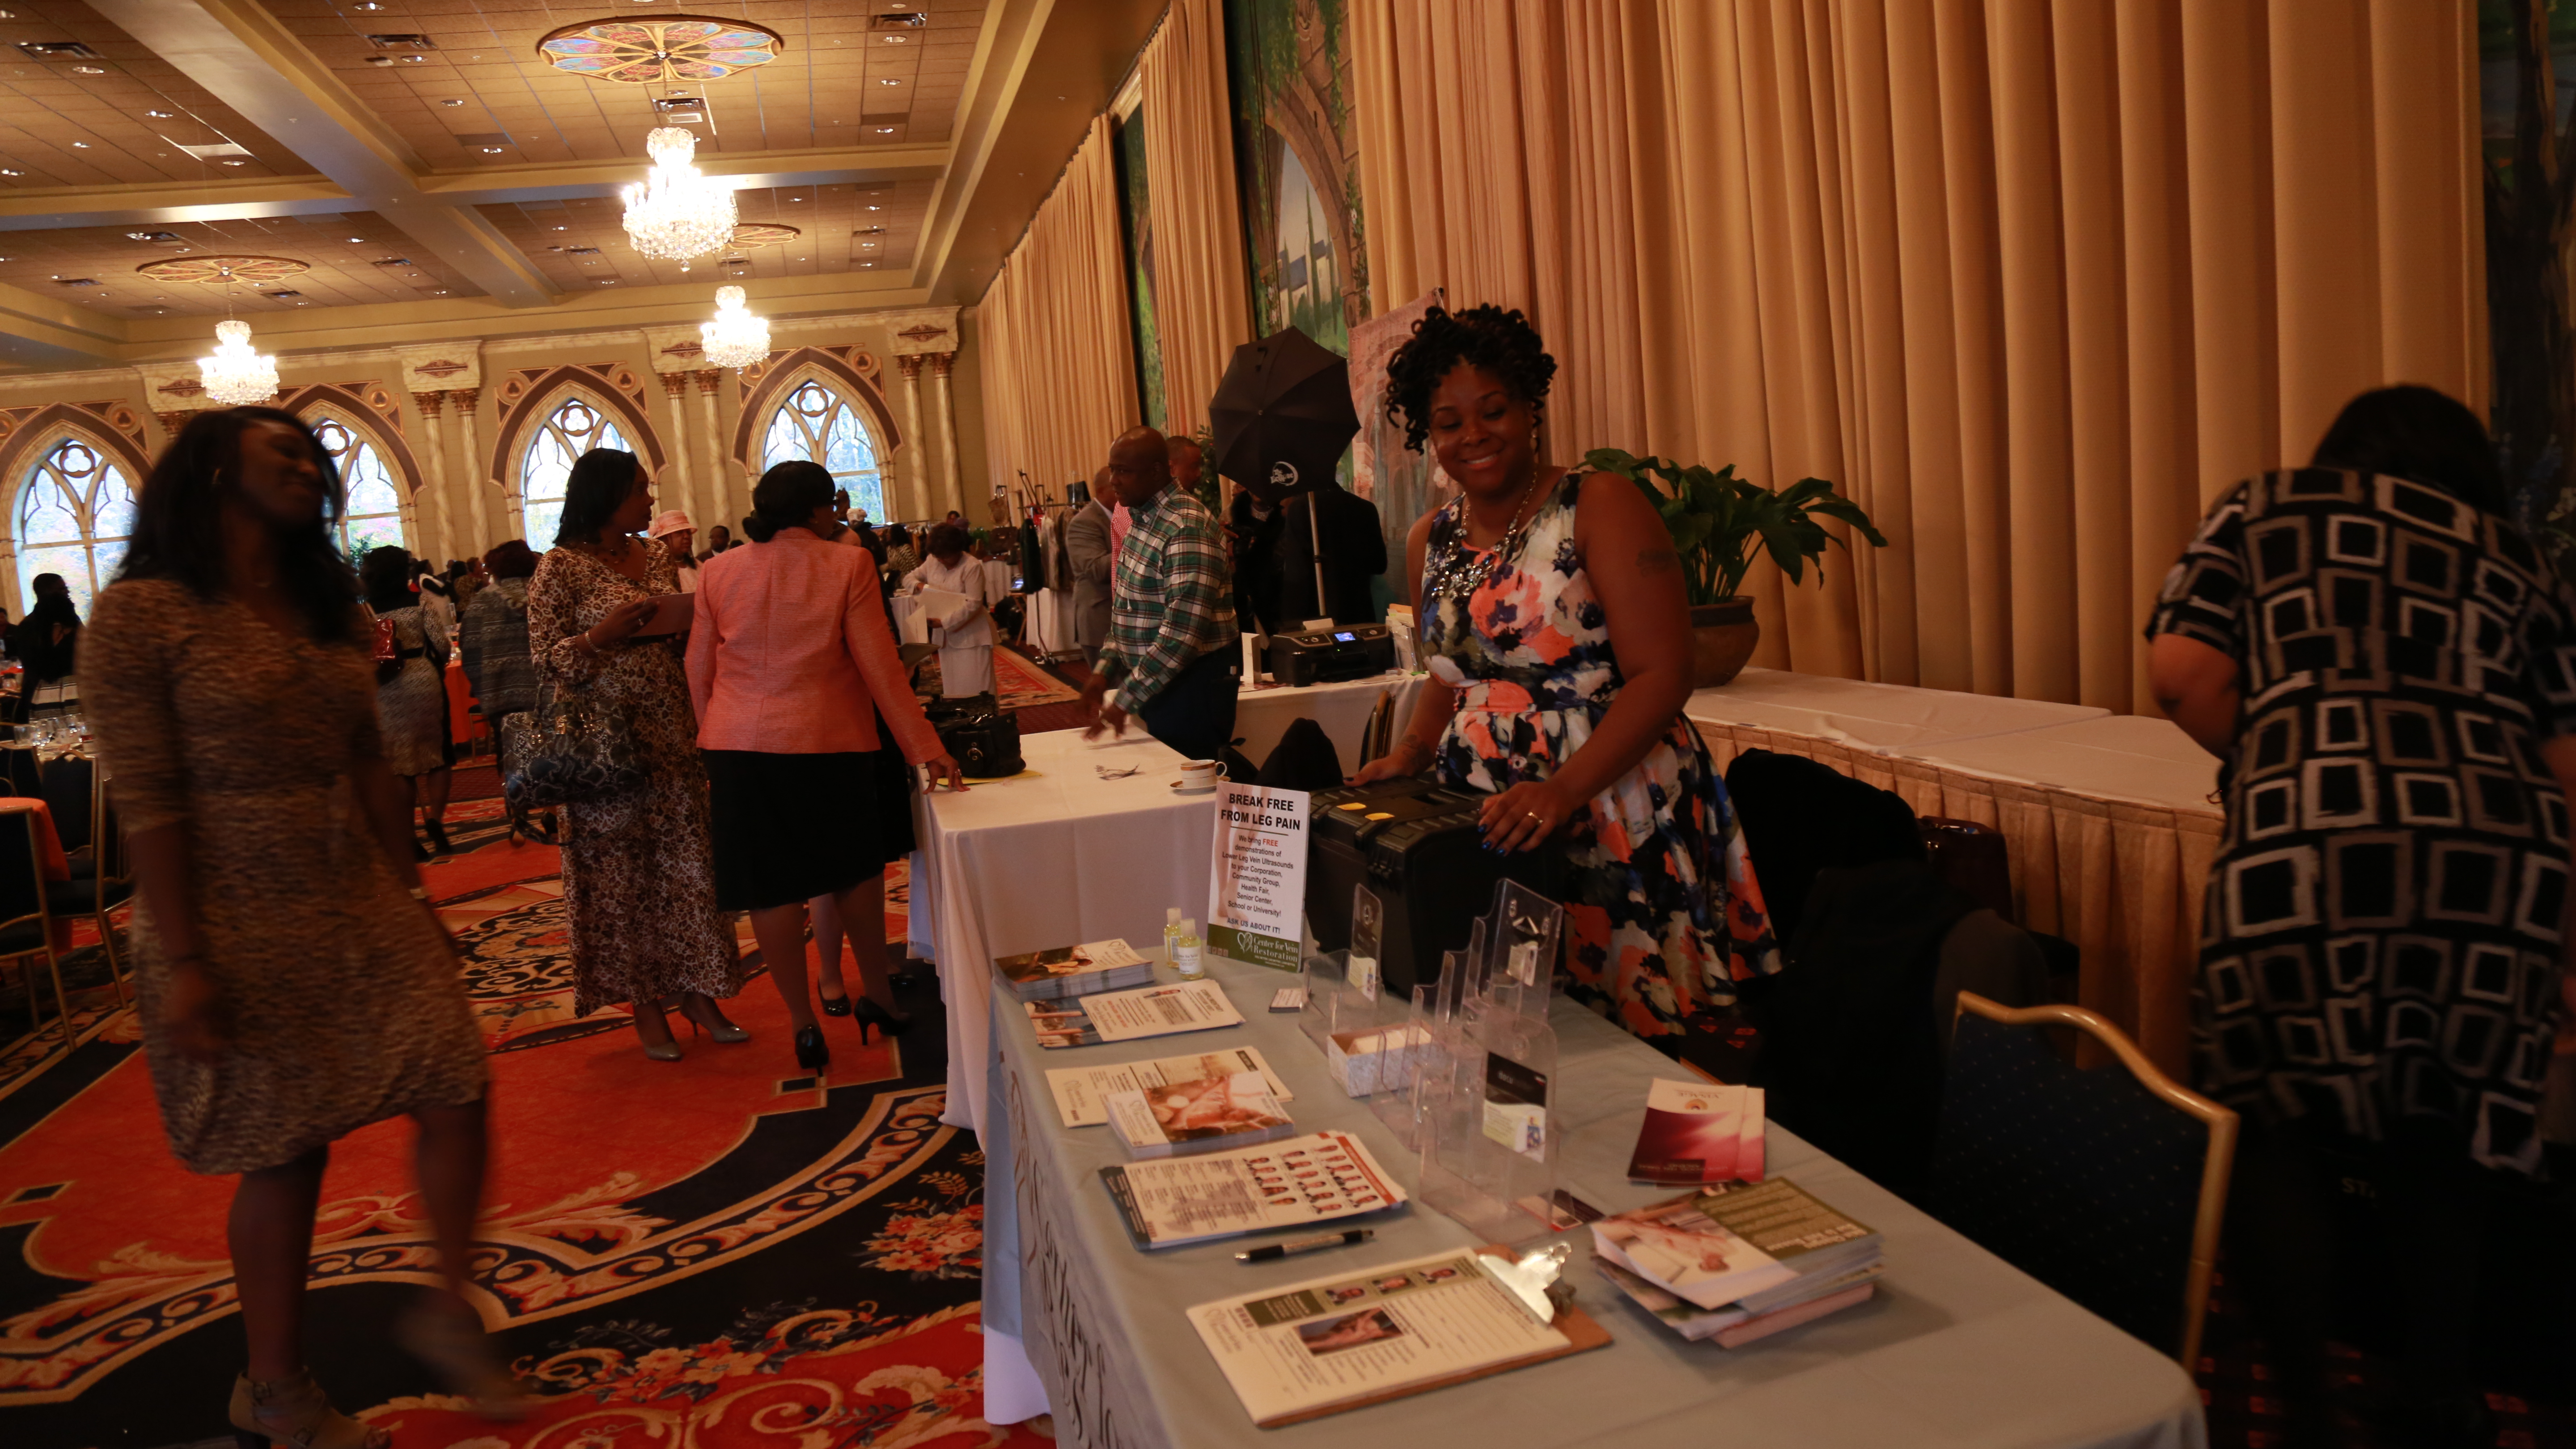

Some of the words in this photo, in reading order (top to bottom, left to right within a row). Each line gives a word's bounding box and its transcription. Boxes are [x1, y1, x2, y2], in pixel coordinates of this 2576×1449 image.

[1229, 793, 1263, 807] BREAK
[1267, 798, 1294, 811] FREE
[1221, 809, 1249, 823] FROM
[1253, 813, 1272, 826] LEG
[1276, 817, 1300, 830] PAIN
[1248, 836, 1261, 845] bring
[1263, 839, 1278, 847] FREE
[1235, 844, 1274, 856] demonstrations
[1239, 854, 1248, 863] Leg
[1262, 858, 1294, 869] Ultrasounds
[1250, 866, 1282, 878] Corporation,
[1232, 873, 1261, 884] Community
[1263, 877, 1280, 888] Group,
[1241, 883, 1257, 892] Health
[1259, 886, 1270, 895] Fair,
[1237, 892, 1253, 901] Senior
[1255, 896, 1273, 906] Center,
[1228, 900, 1246, 910] School
[1254, 906, 1281, 917] University!
[1227, 917, 1239, 925] ASK
[1250, 922, 1271, 932] ABOUT
[1254, 936, 1274, 948] Center
[1275, 941, 1284, 950] for
[1284, 942, 1298, 953] Vein
[1254, 945, 1297, 962] Restoration
